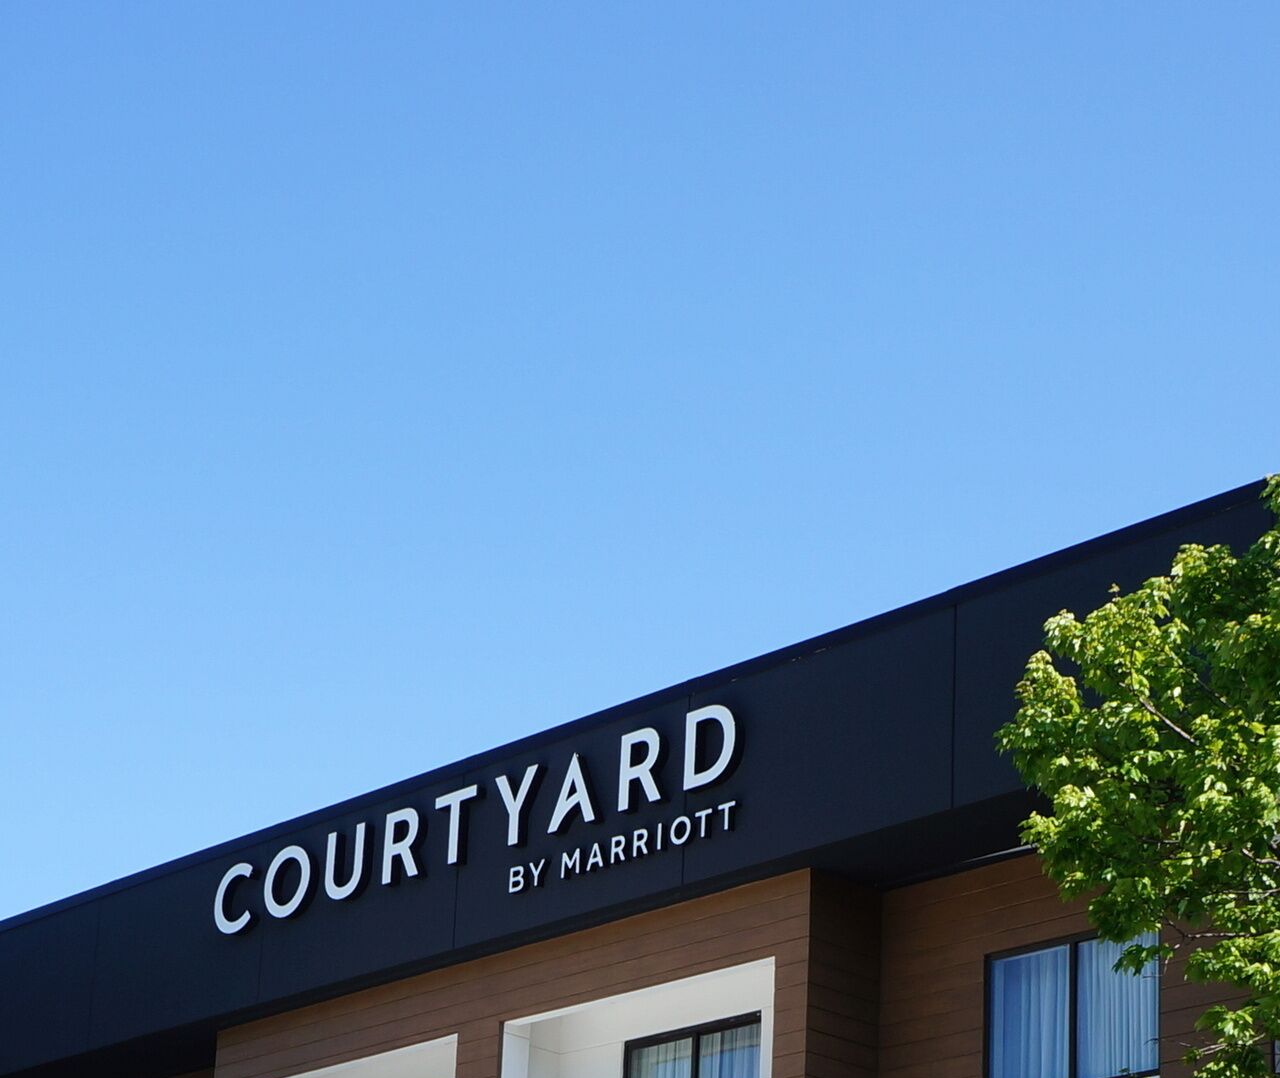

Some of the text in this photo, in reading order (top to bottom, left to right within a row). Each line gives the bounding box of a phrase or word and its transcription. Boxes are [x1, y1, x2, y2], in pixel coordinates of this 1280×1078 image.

[213, 704, 736, 935] COURTYARD
[508, 800, 736, 894] BY MARRIOTT
